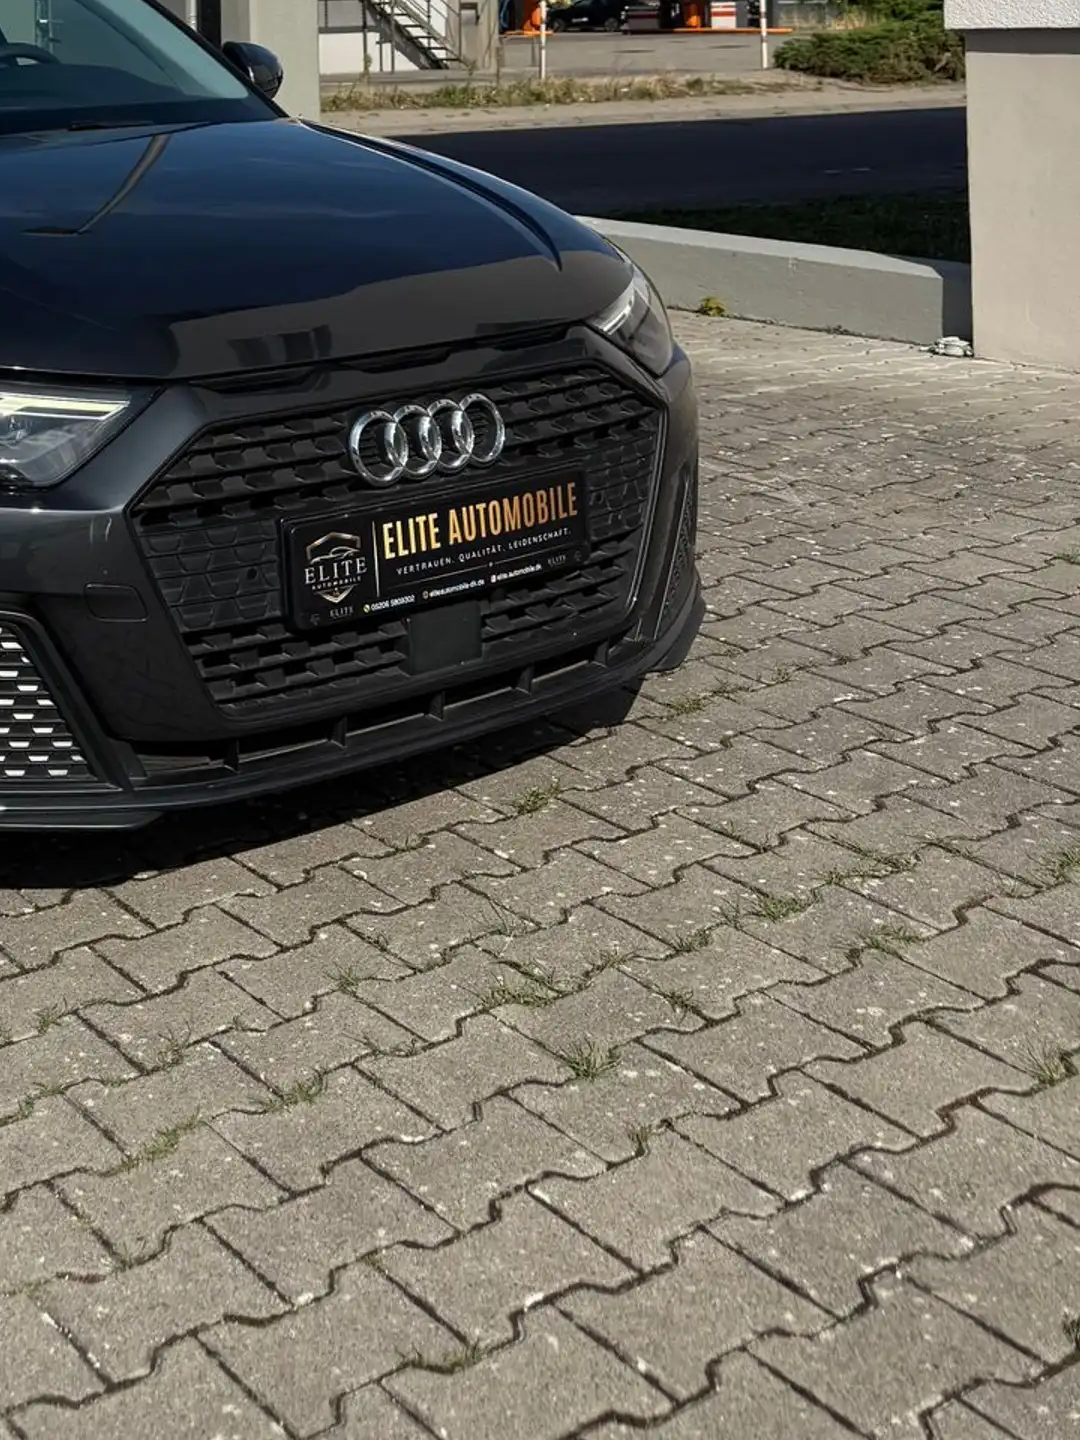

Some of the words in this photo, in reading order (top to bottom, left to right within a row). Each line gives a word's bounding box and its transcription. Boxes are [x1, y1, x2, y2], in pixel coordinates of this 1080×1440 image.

[383, 513, 441, 560] ELITE
[448, 482, 577, 545] AUTOMOBILE
[304, 557, 367, 585] ELITE
